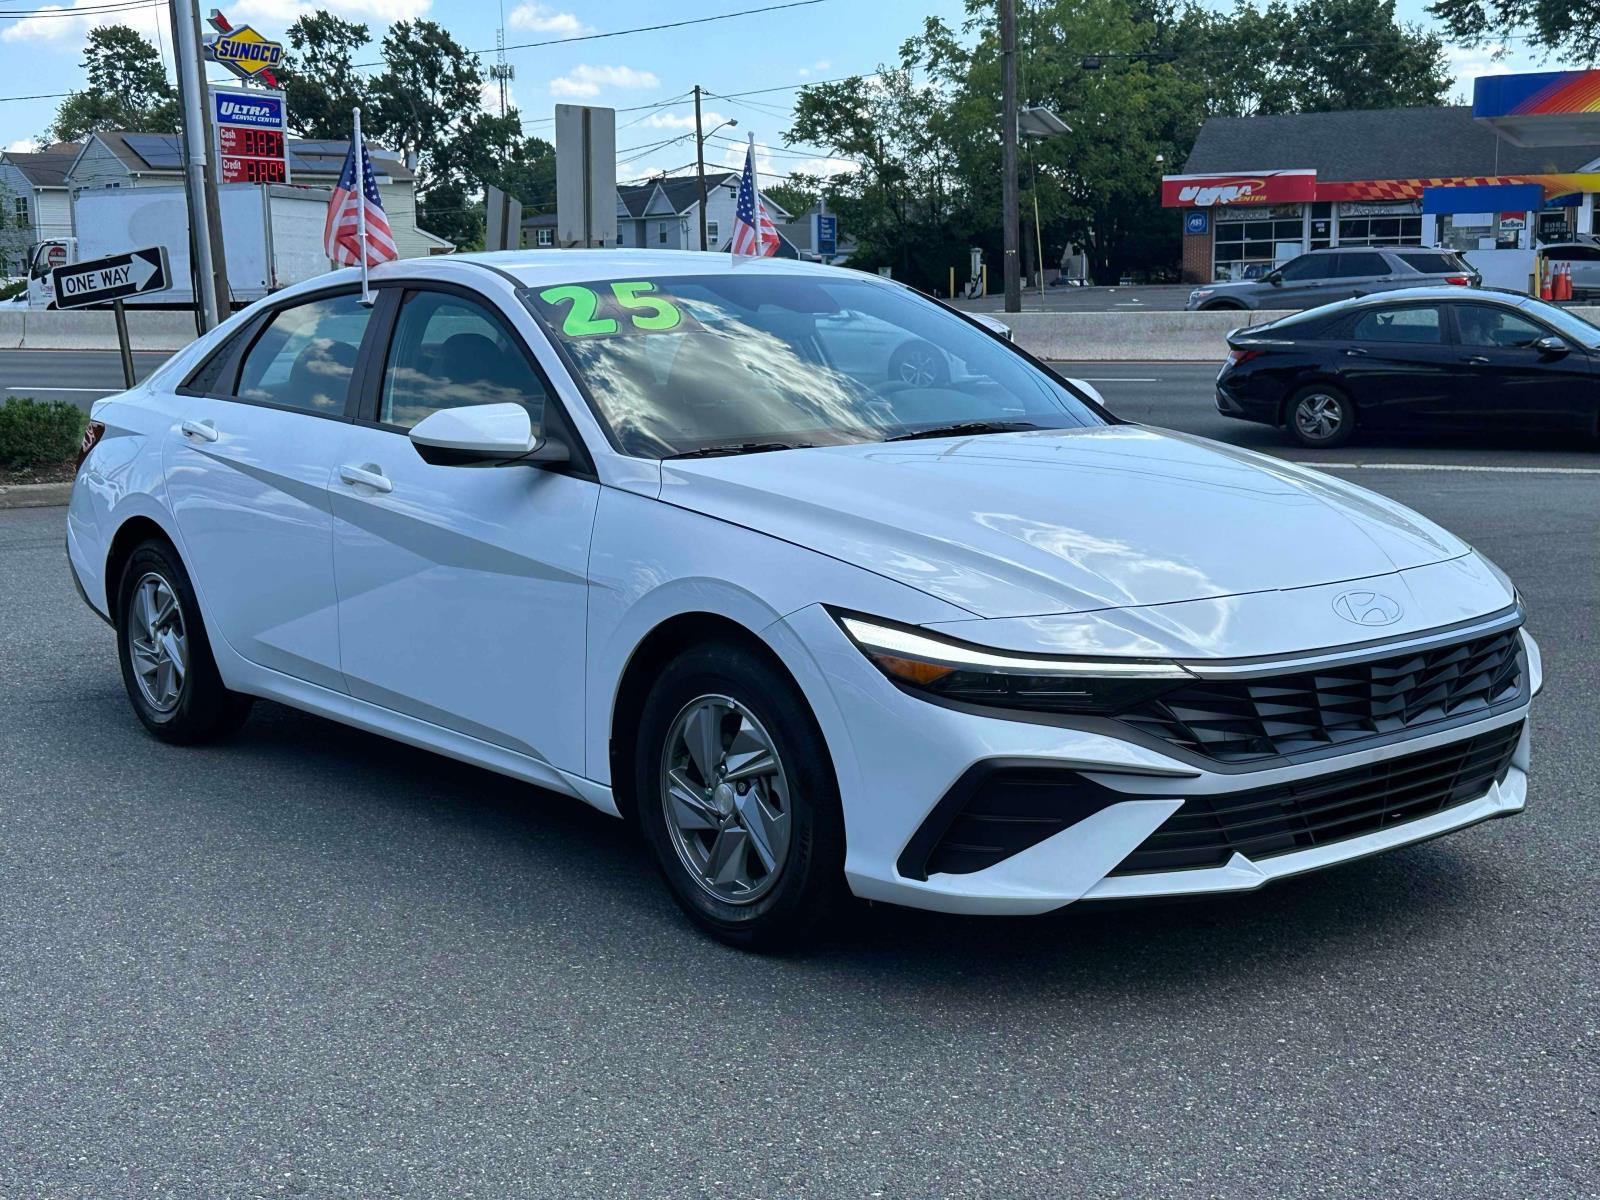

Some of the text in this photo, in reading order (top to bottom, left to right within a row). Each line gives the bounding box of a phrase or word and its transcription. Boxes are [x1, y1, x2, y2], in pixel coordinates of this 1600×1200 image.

[219, 40, 281, 63] SUNOCO
[220, 101, 270, 116] ULTRA
[232, 114, 280, 124] SERVICE CENTER
[220, 128, 236, 139] Cash
[223, 159, 242, 170] Credit
[66, 273, 97, 294] ONE
[100, 266, 131, 287] WAY
[540, 281, 681, 337] 25
